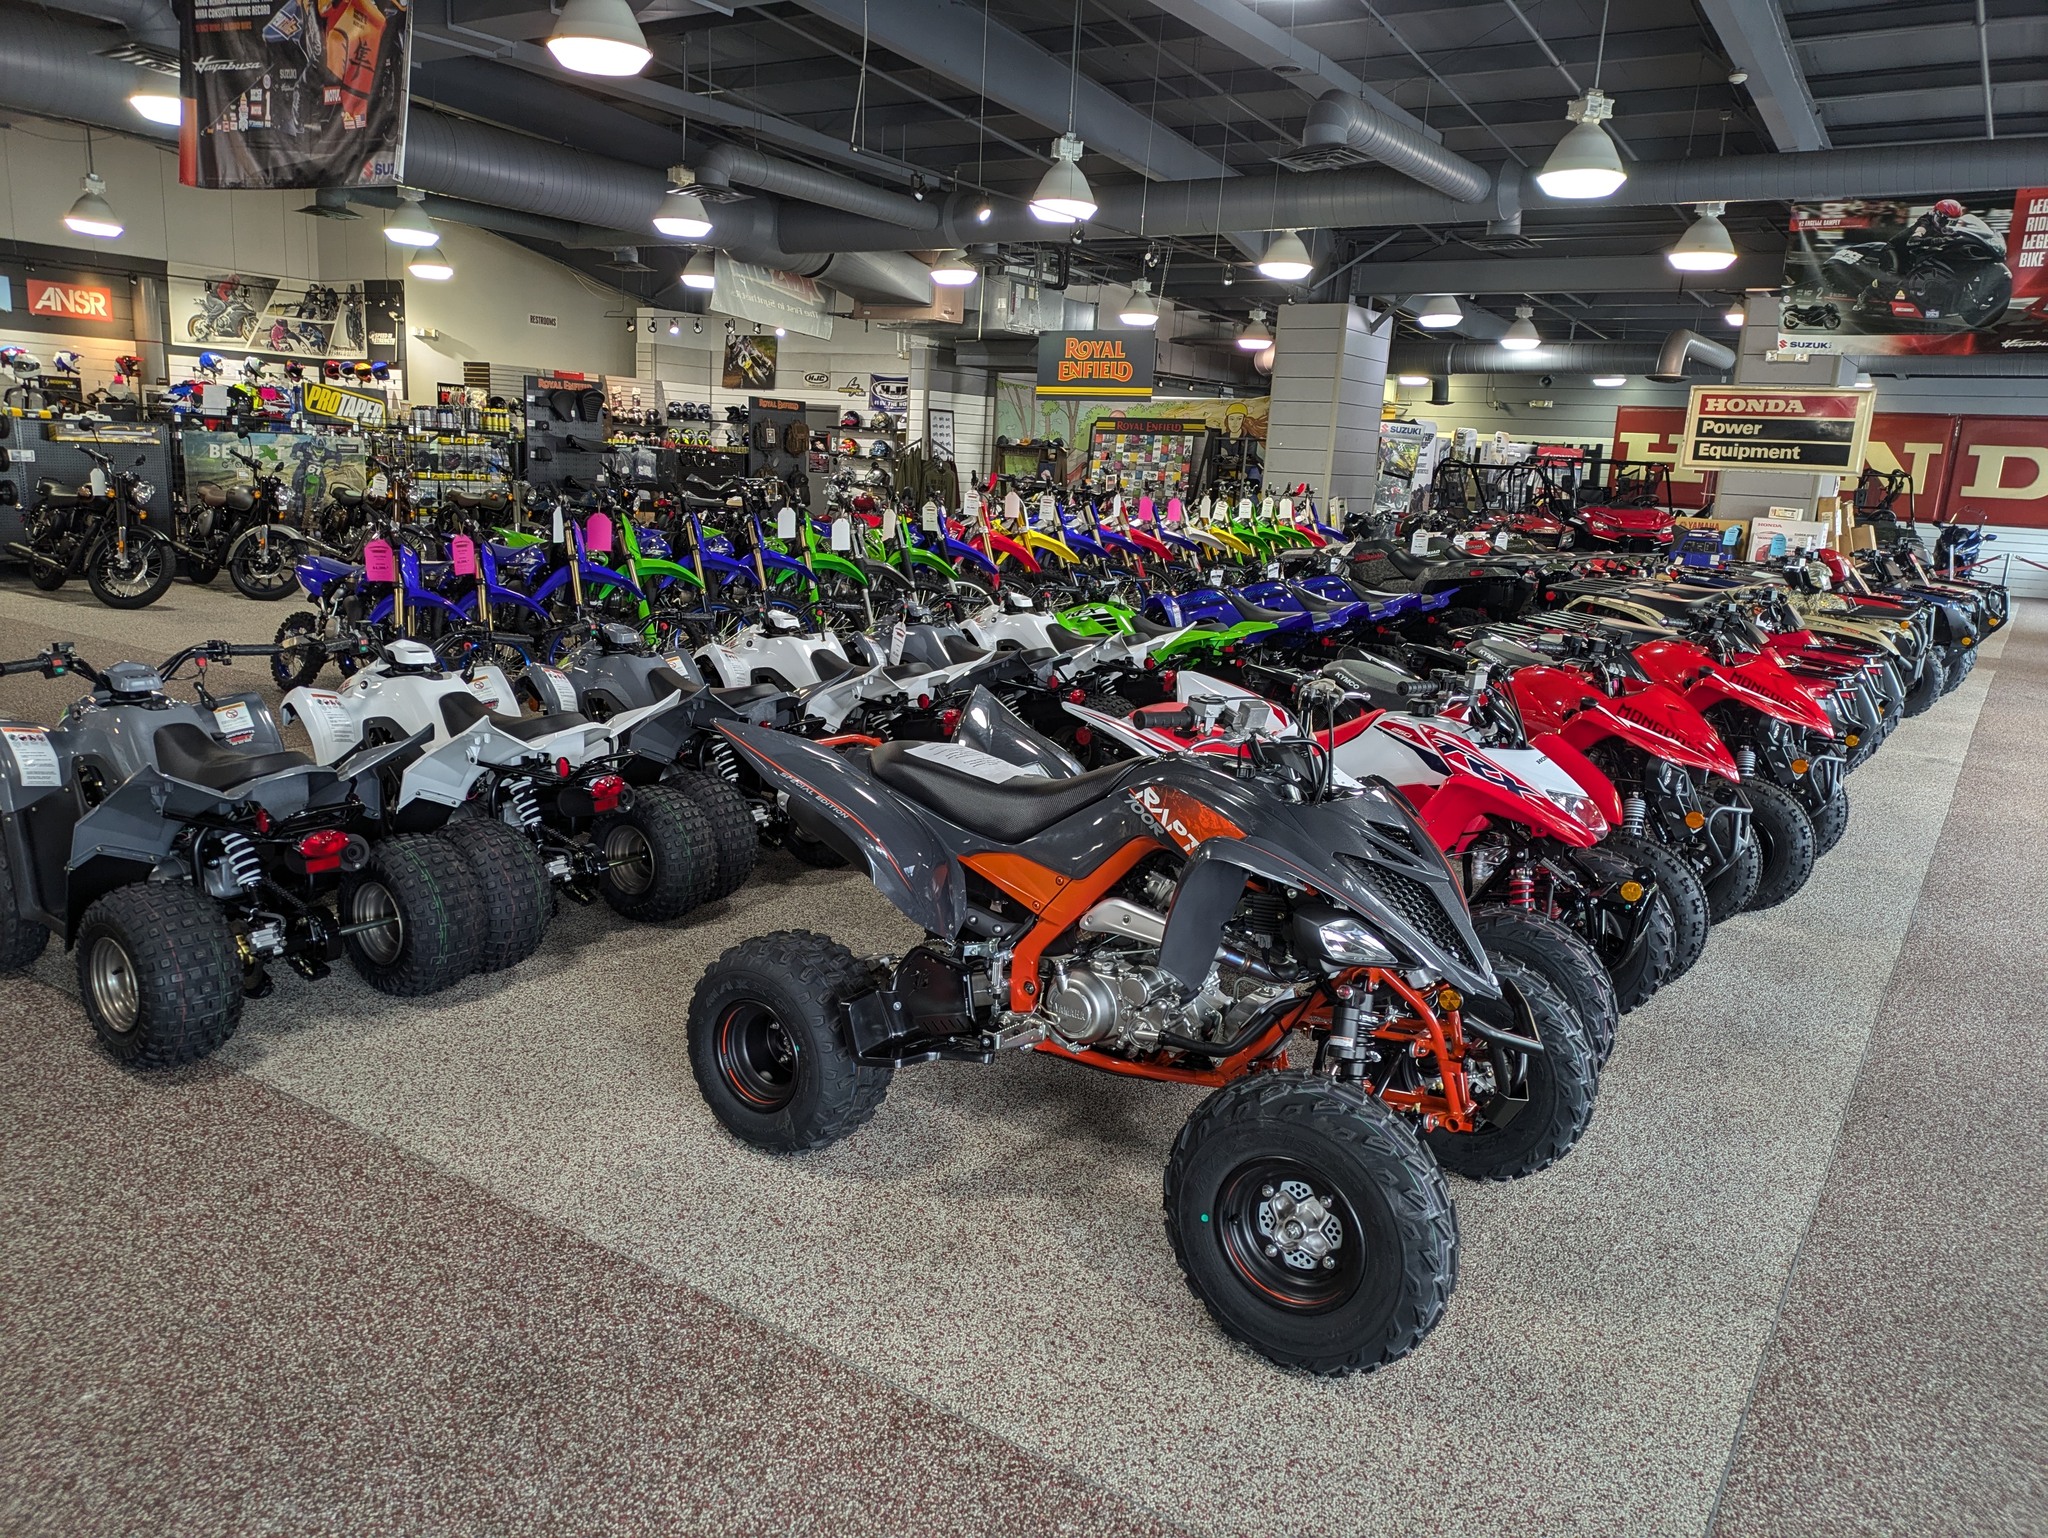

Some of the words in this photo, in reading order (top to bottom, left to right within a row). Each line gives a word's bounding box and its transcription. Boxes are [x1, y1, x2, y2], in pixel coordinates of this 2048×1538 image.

[252, 5, 270, 15] RECORD
[192, 55, 261, 73] Hayabusa
[2019, 252, 2046, 267] BIKE
[35, 286, 108, 317] ANSR
[530, 315, 557, 327] RESTROOMS
[1065, 337, 1126, 360] ROYAL
[1057, 361, 1134, 382] ENFIELD
[538, 378, 563, 390] ROYAL
[758, 398, 777, 408] ROYAL
[1704, 398, 1806, 413] HONDA
[1116, 420, 1144, 432] ROYAL
[1146, 422, 1183, 433] ENFIELD
[1390, 425, 1422, 435] SUZUKI
[1702, 420, 1762, 435] Power
[209, 443, 231, 458] BE
[1698, 442, 1801, 460] Equipment
[1688, 521, 1720, 531] YAMAHA
[1478, 649, 1502, 664] KYMCO
[1335, 671, 1360, 690] KYMCO
[780, 772, 814, 796] SPECIAL
[815, 795, 849, 819] EDITION
[1124, 793, 1165, 837] 700R
